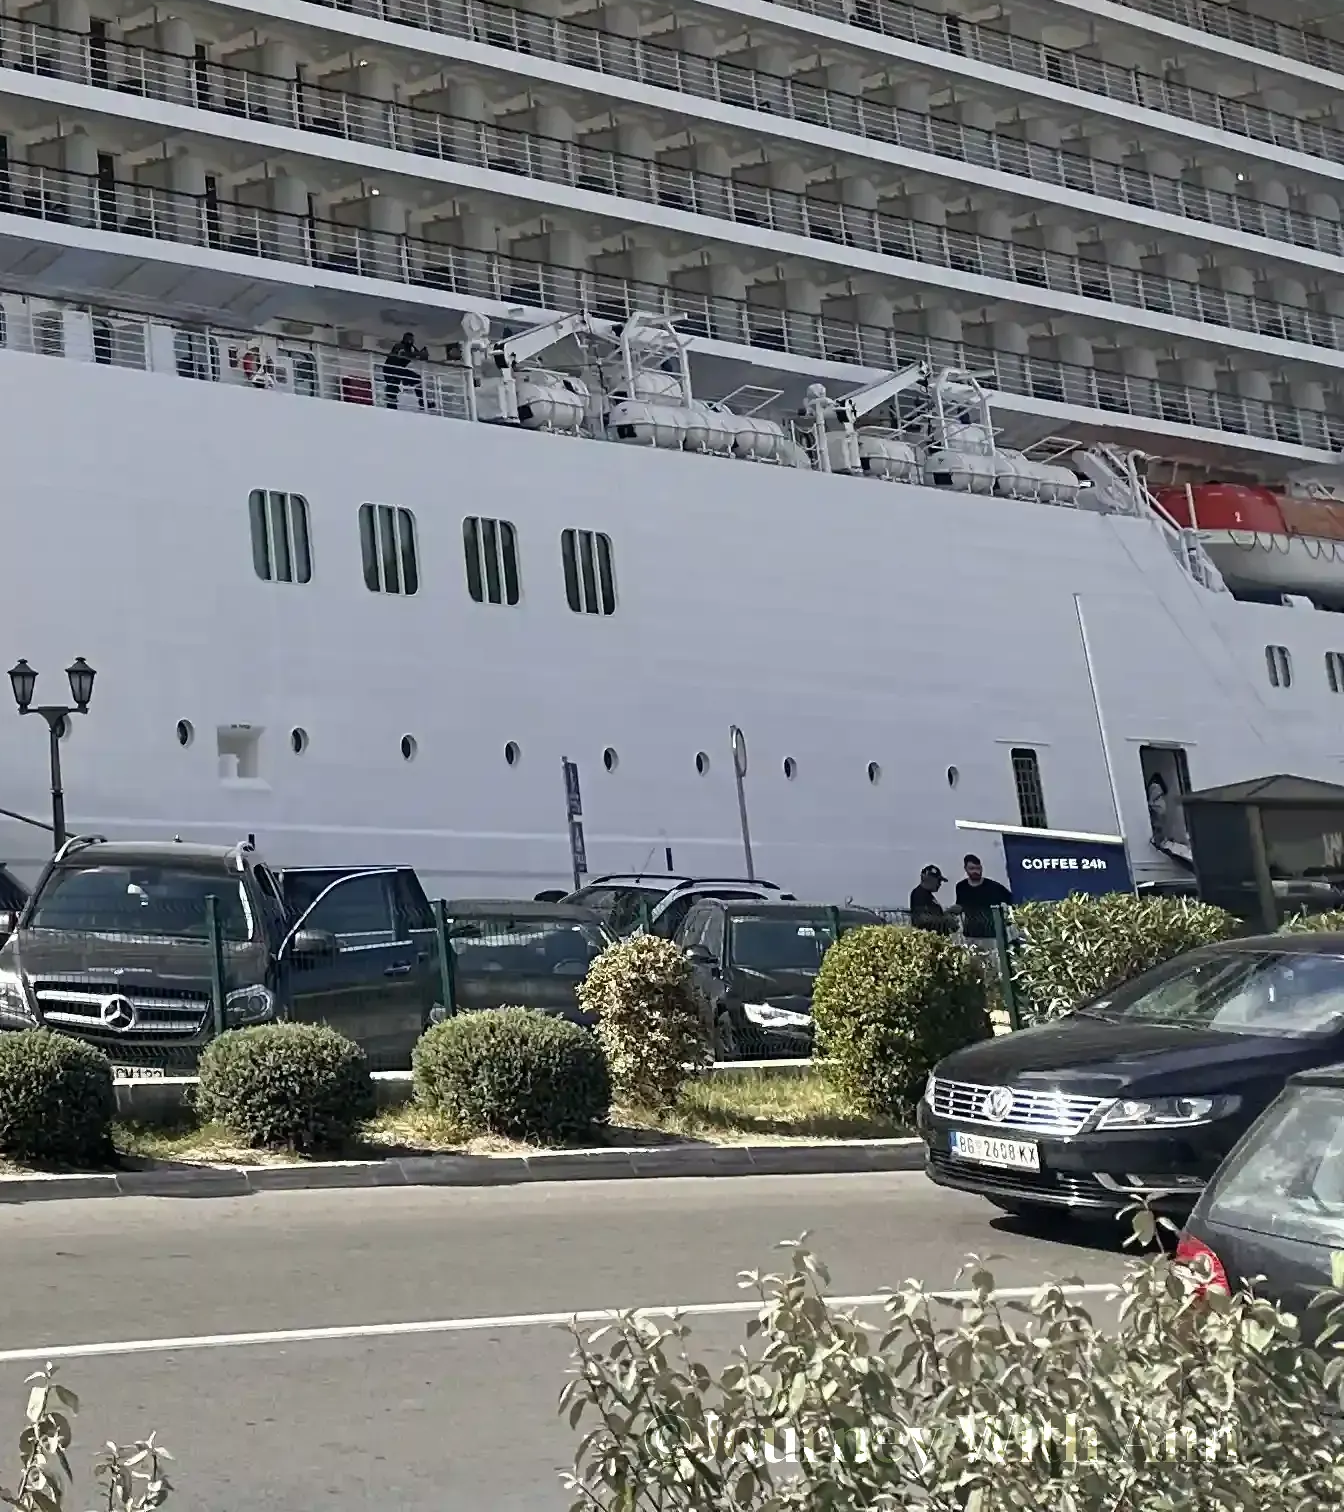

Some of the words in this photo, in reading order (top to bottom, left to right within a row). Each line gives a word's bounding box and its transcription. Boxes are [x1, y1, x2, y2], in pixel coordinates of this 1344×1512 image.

[1021, 857, 1079, 870] COFFEE
[1081, 857, 1107, 870] 24h
[959, 1135, 975, 1155] BG
